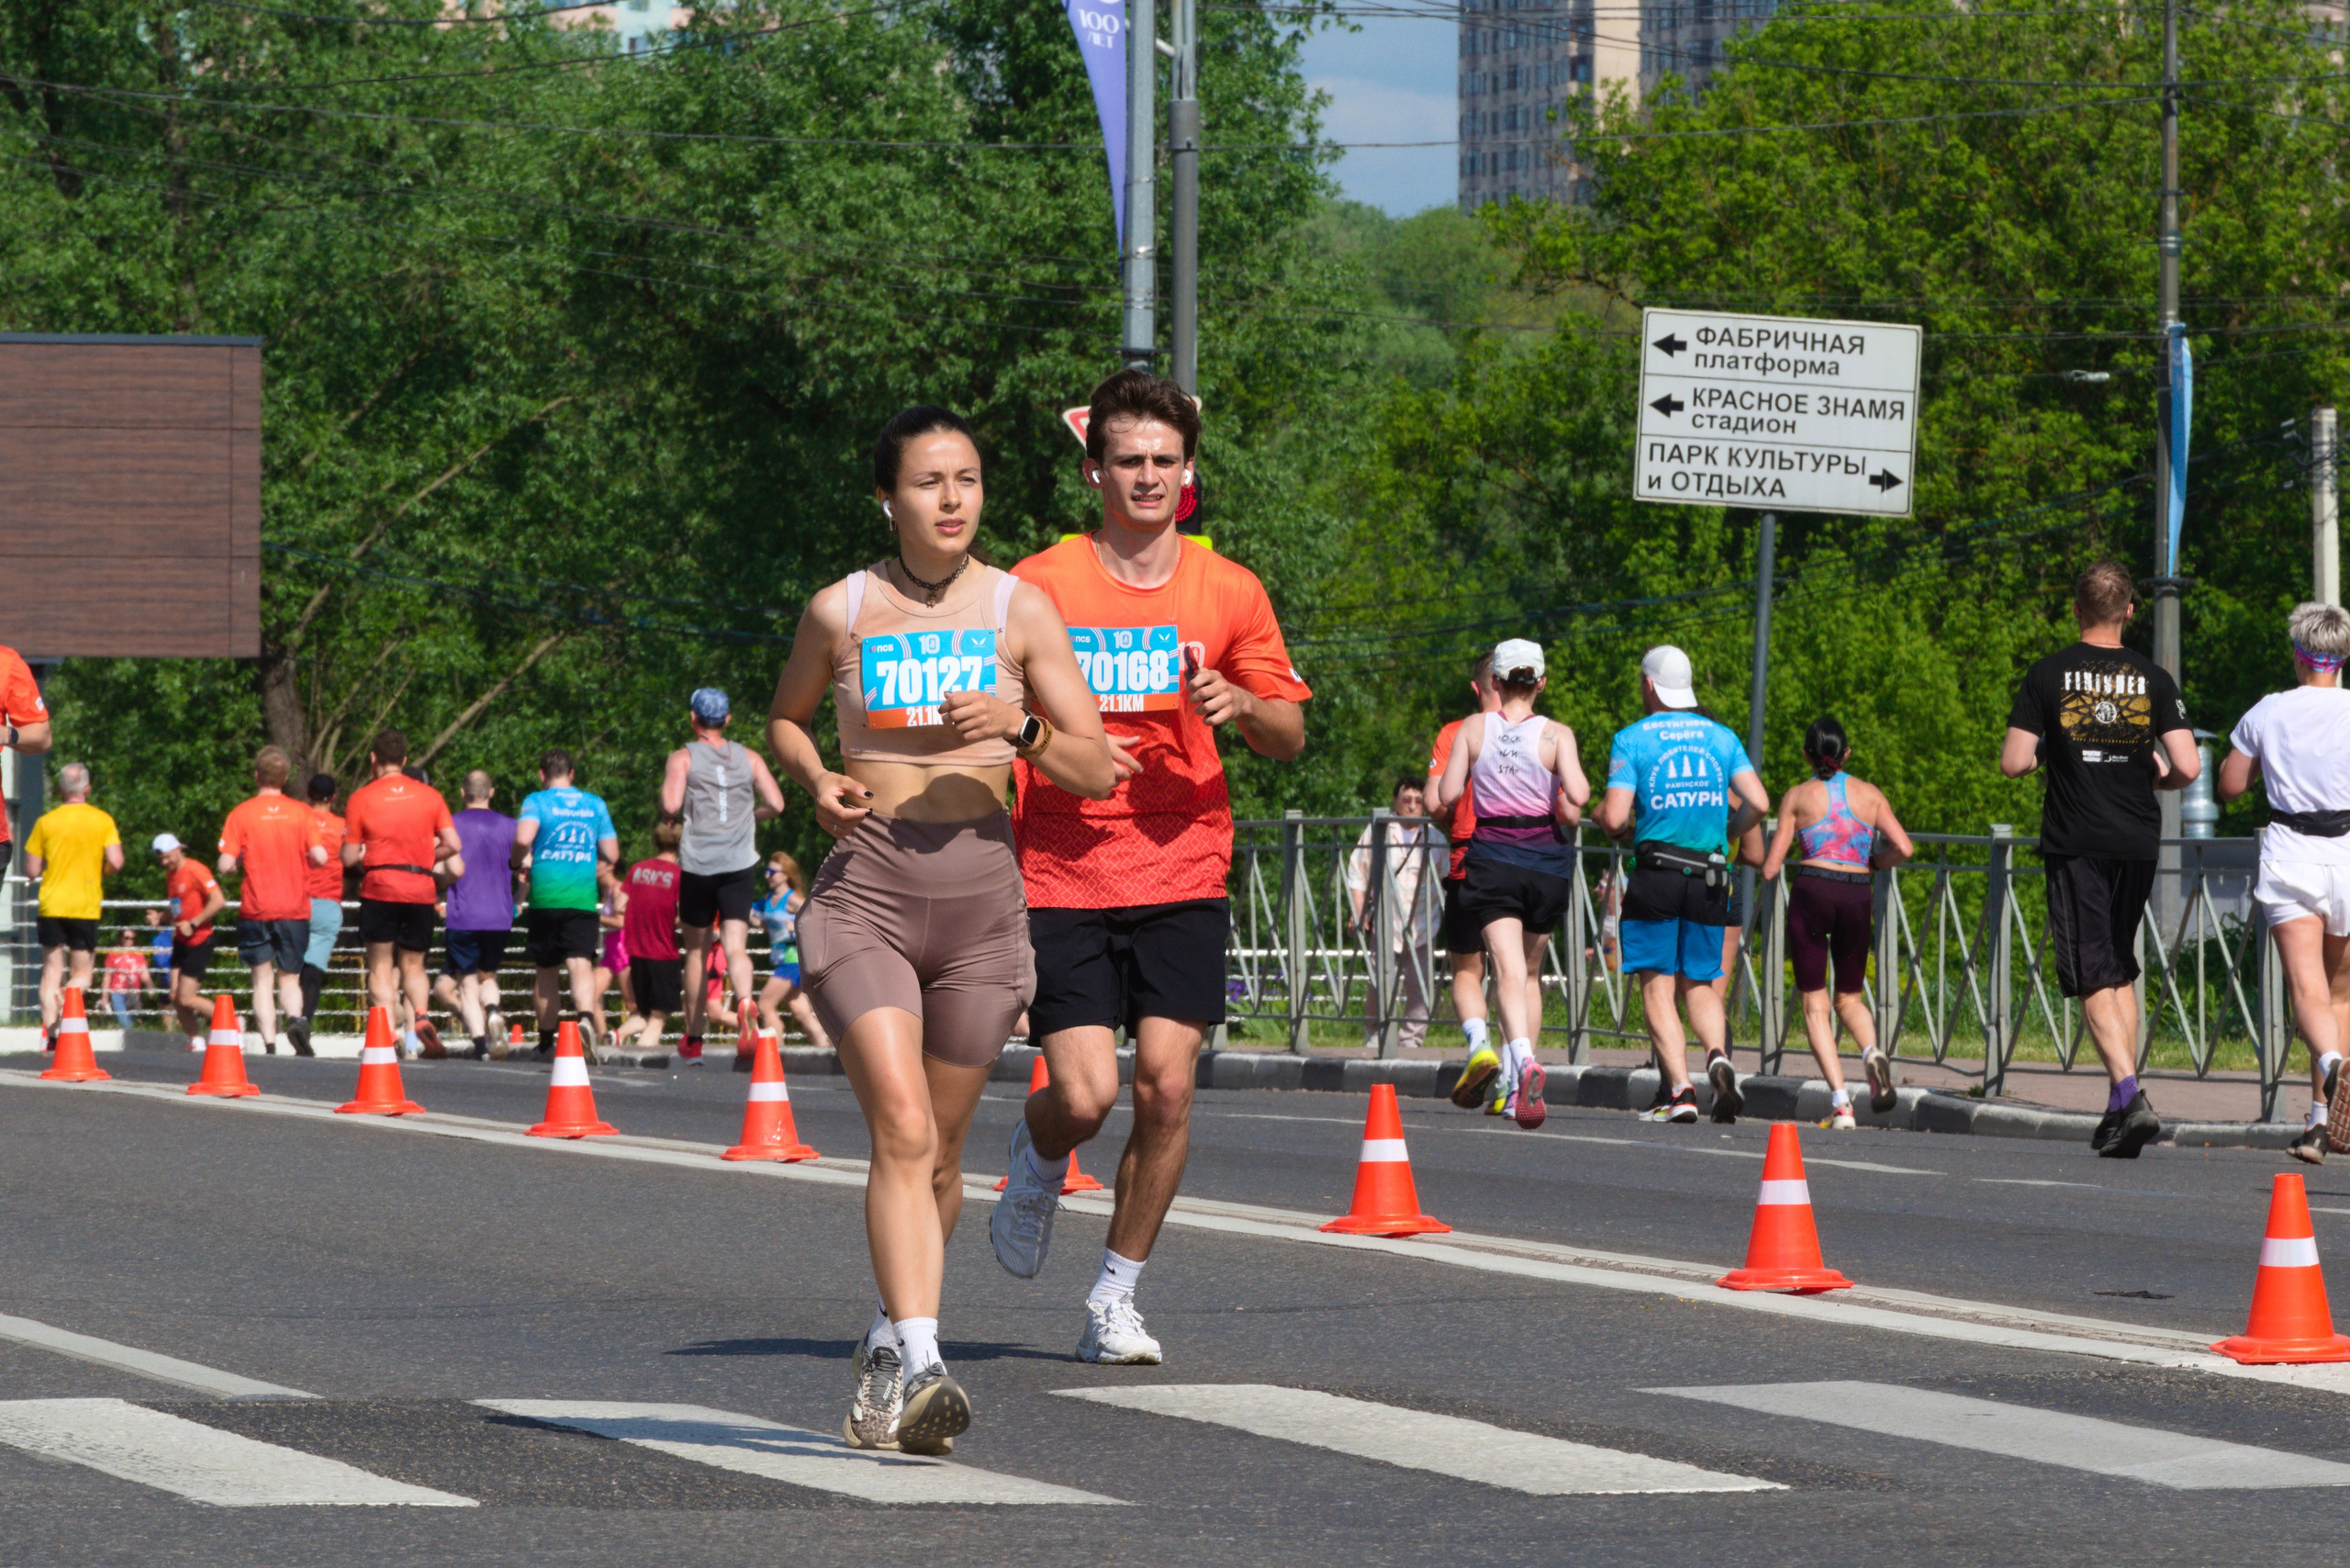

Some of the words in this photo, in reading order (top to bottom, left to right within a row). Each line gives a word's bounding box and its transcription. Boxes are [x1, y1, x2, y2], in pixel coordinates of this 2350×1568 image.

[1078, 8, 1120, 34] 100
[1696, 327, 1865, 355] ФАБРИЧНАЯ
[1695, 353, 1840, 378] платформа
[1693, 387, 1808, 414] КРАСНОЕ
[1817, 396, 1905, 420] ЗНАМЯ
[1692, 413, 1796, 434] стадион
[1650, 442, 1719, 465] ПАРК
[1728, 446, 1866, 476] КУЛЬТУРЫ
[1648, 474, 1662, 490] и
[1672, 471, 1786, 498] ОТДЫХА
[877, 644, 894, 653] ПСБ
[877, 655, 983, 706] 70127
[1075, 649, 1169, 691] 70168
[2065, 671, 2145, 694] FINISHER
[1099, 694, 1144, 712] 21.1KM
[906, 706, 948, 727] 21.1K
[1651, 791, 1723, 811] САТУРН
